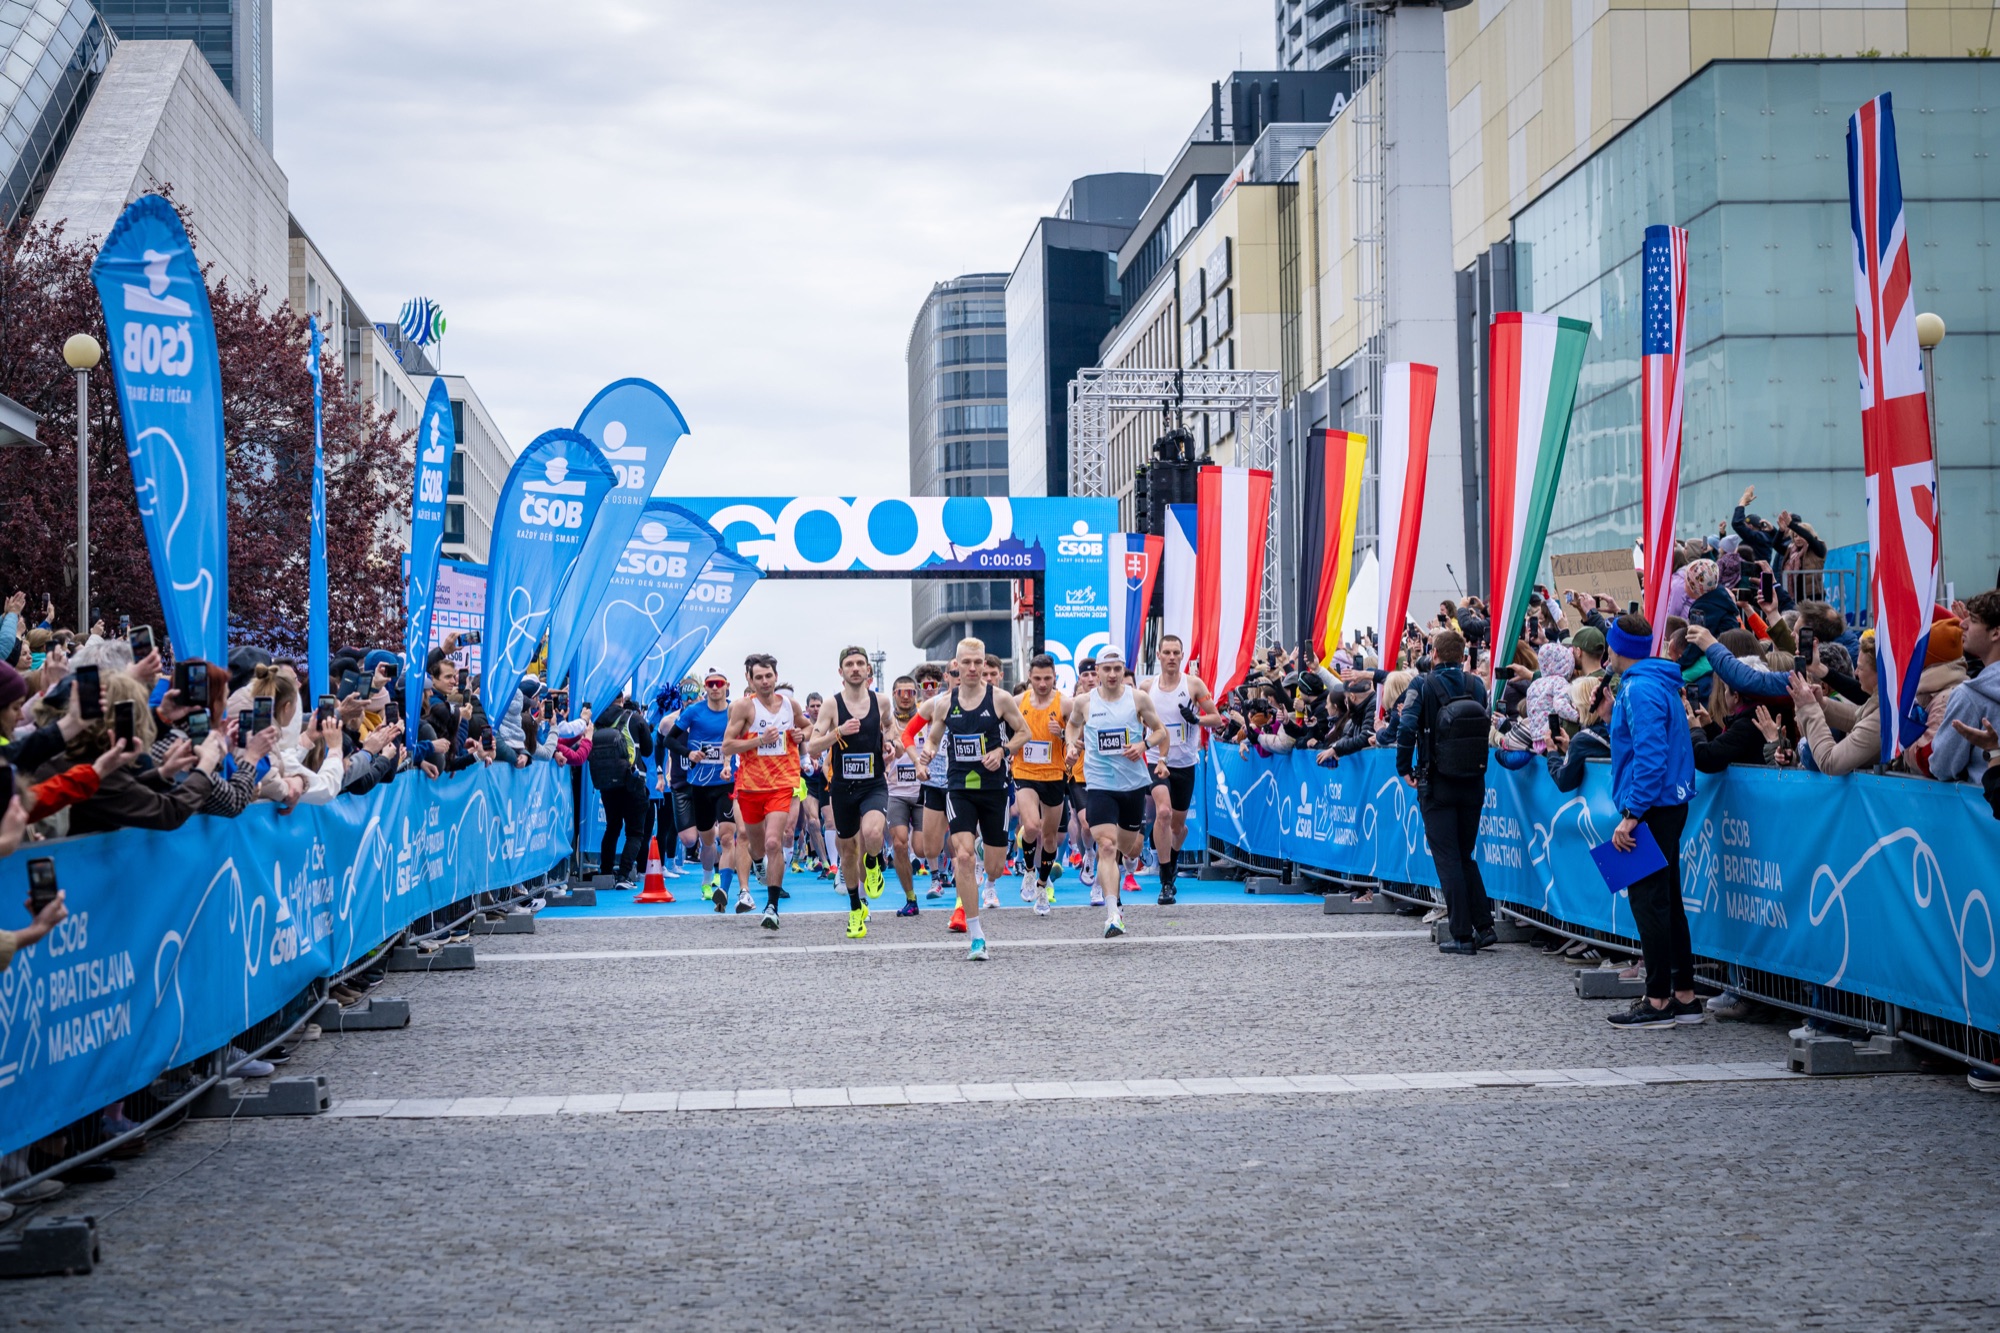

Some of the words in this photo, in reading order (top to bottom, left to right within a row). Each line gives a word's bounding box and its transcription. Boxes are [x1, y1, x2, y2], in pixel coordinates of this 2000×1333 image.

[420, 464, 444, 503] ČSOB
[612, 464, 646, 489] OB
[519, 492, 584, 529] ČSOB
[516, 529, 538, 539] KAŽDÝ
[539, 533, 553, 541] DEŇ
[555, 534, 580, 544] SMART
[1057, 541, 1103, 556] ČSOB
[979, 553, 1032, 567] 0:00:05
[610, 576, 635, 586] KAŽDÝ
[638, 578, 654, 588] DEŇ
[657, 580, 684, 590] SMART
[684, 583, 733, 604] SOB
[706, 606, 729, 614] SMART
[956, 744, 974, 754] 15157
[1024, 747, 1033, 757] 37
[1100, 737, 1120, 748] 14349
[845, 762, 864, 772] 15071
[1721, 810, 1751, 848] ČSOB
[1723, 854, 1783, 892] BRATISLAVA
[1726, 890, 1788, 930] MARATHON
[269, 925, 297, 966] ČSOB
[49, 950, 135, 1012] BRATISLAVA
[48, 999, 131, 1065] MARATHON
